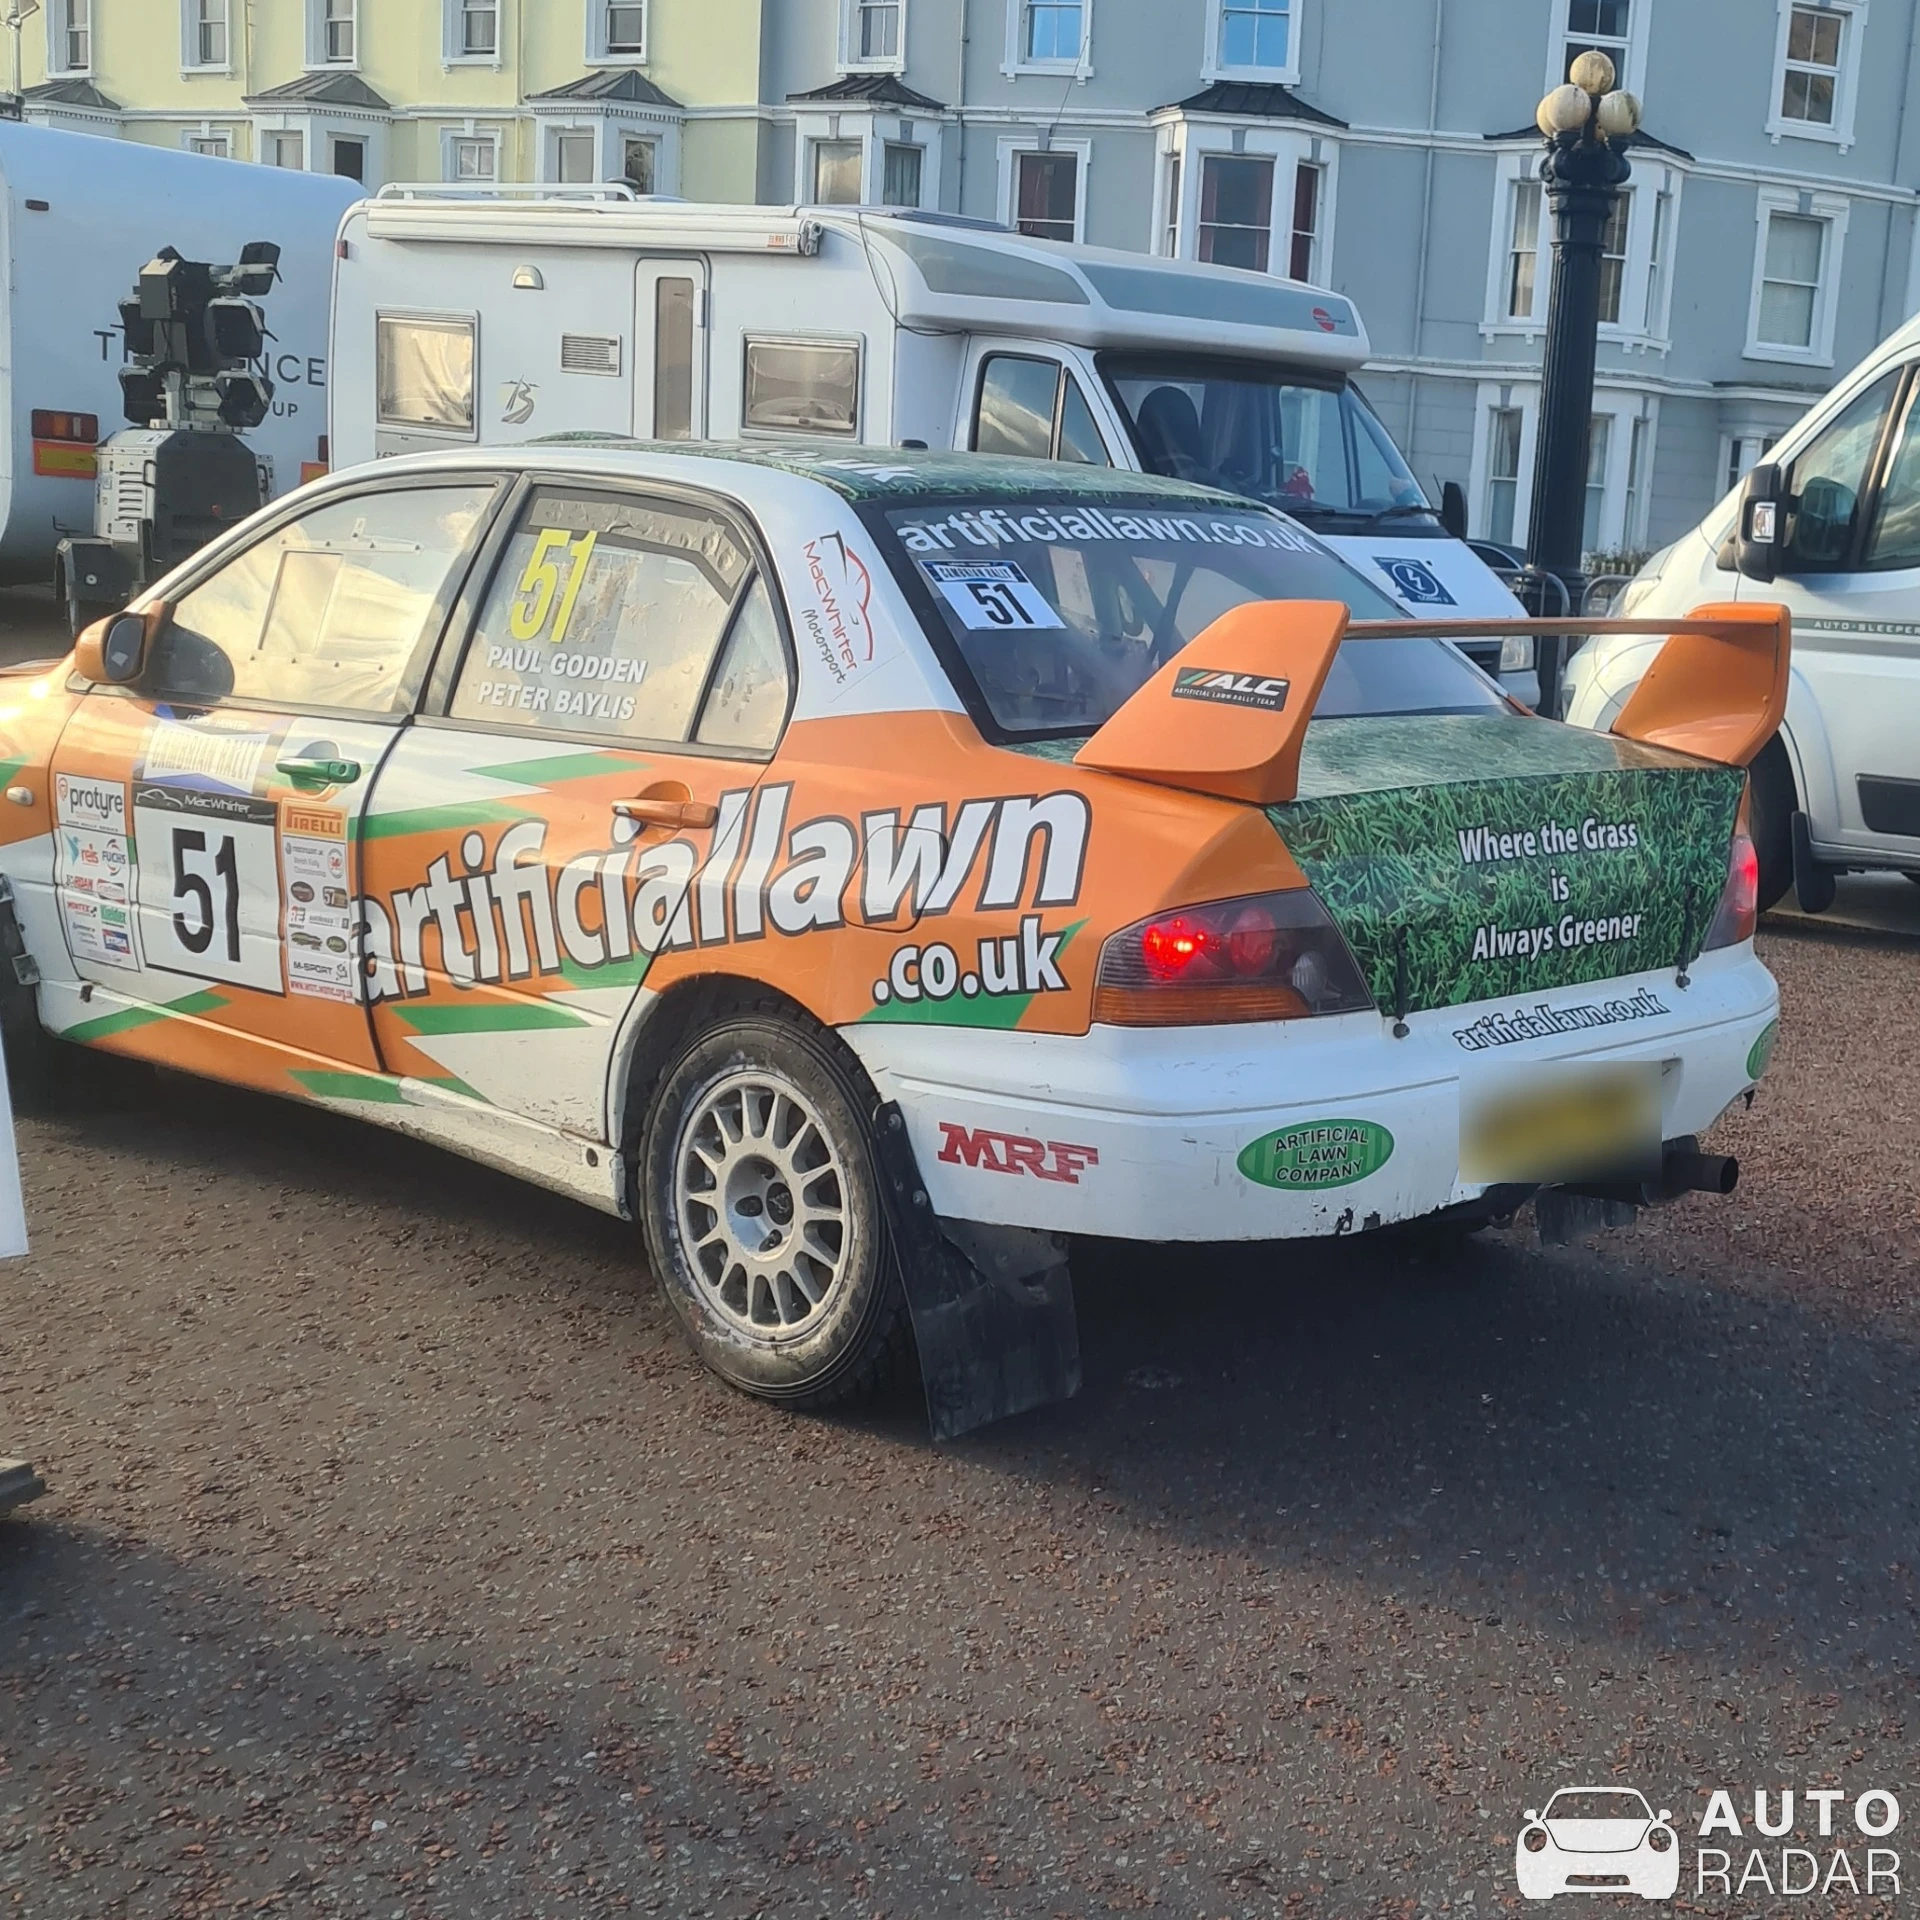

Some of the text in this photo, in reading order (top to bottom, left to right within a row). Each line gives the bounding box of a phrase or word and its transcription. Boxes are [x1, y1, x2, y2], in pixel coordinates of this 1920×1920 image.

[896, 506, 1325, 557] artificiallawn.co.uk
[509, 528, 598, 644] 51
[803, 540, 858, 671] MacWhirter
[965, 582, 1036, 625] 51
[486, 645, 648, 684] PAUL GODDEN
[801, 608, 847, 685] Motorsport
[478, 680, 637, 720] PETER BAYLIS
[1174, 687, 1210, 697] ARTIFICIAL
[1256, 697, 1276, 706] TEAM
[1203, 674, 1288, 696] ALC
[69, 786, 123, 819] protyre
[184, 794, 251, 814] MacWhirter
[286, 806, 343, 835] PIRELLI
[101, 850, 127, 864] FUCHS
[1457, 817, 1640, 864] Where the Grass
[171, 827, 242, 963] 51
[351, 781, 1092, 1006] artificiallawn
[1550, 867, 1570, 901] is
[1471, 913, 1643, 962] Always Greener
[293, 961, 333, 975] M-SPORT
[871, 914, 1070, 1005] .co.uk
[1452, 987, 1672, 1051] artificiallawn.co.uk
[937, 1121, 1100, 1185] MRF
[1274, 1127, 1369, 1154] ARTIFICIAL
[1298, 1143, 1348, 1164] LAWN
[1276, 1159, 1363, 1184] COMPANY
